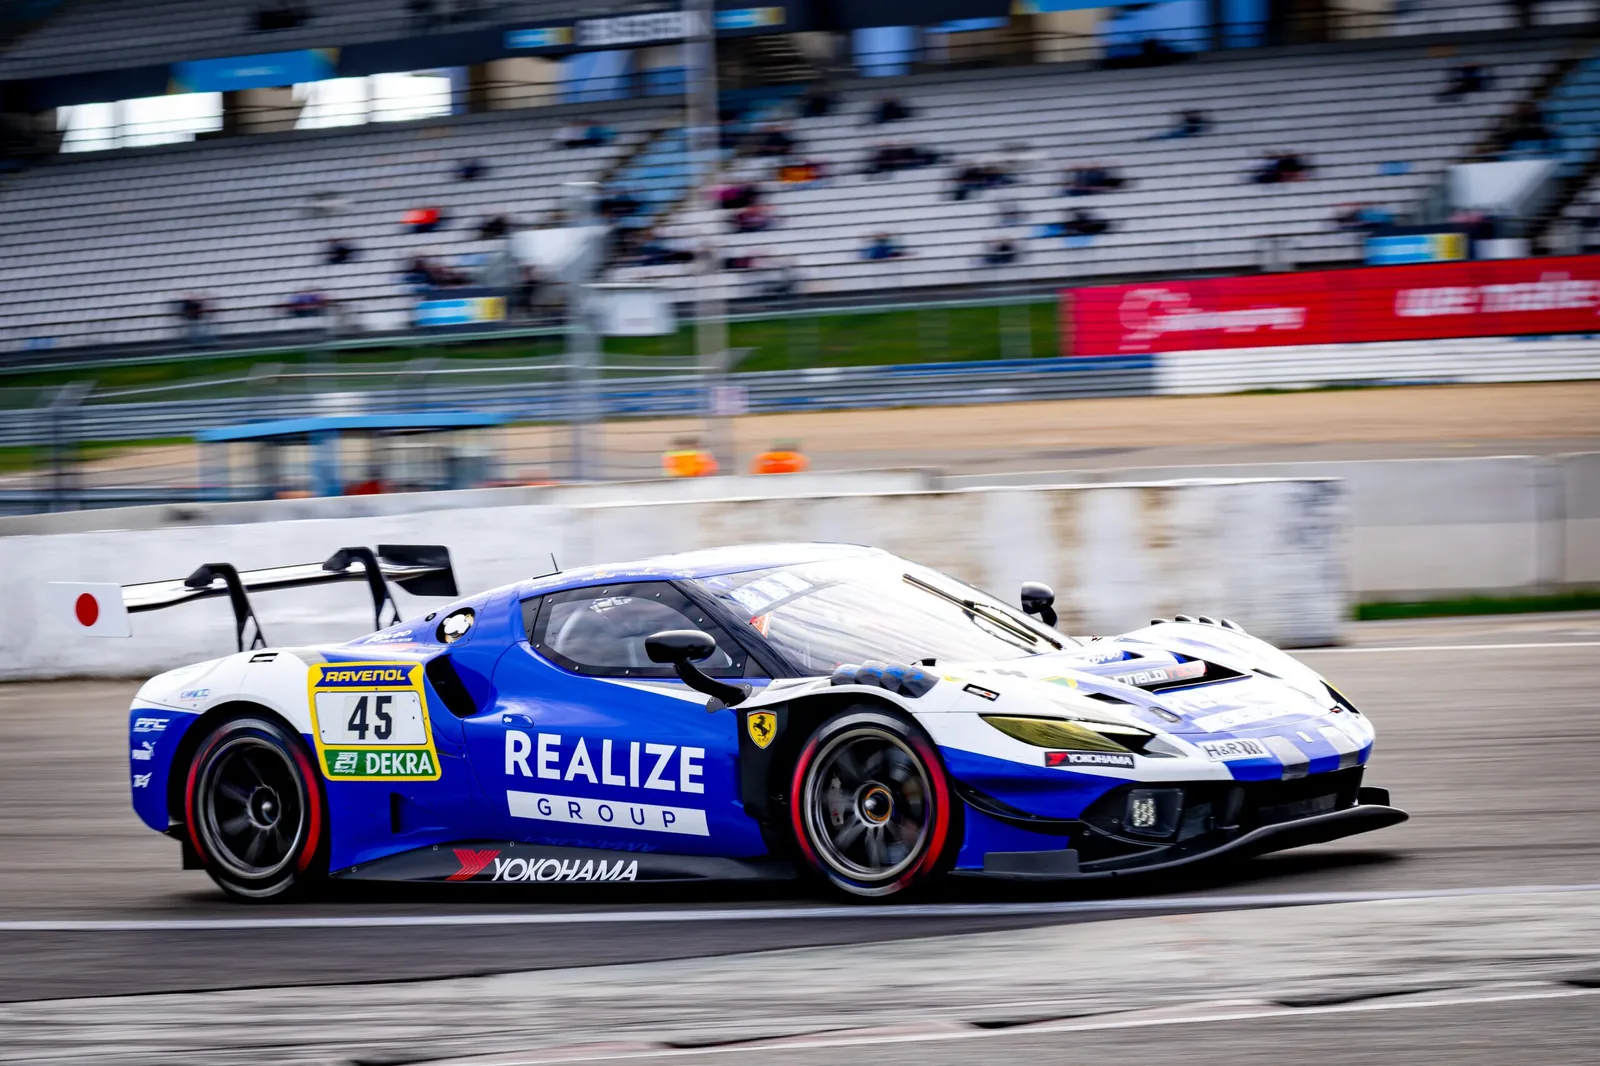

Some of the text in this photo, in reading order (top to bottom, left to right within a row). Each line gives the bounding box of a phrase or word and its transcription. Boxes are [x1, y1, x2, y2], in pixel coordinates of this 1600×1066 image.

[325, 669, 406, 682] RAVENOL
[347, 695, 393, 740] 45
[1067, 753, 1133, 767] YOKOHAMA
[1202, 742, 1241, 758] H&R
[365, 752, 434, 774] DEKRA
[505, 730, 705, 794] REALIZE
[537, 798, 676, 828] GROUP
[491, 857, 638, 882] YOKOHAMA
